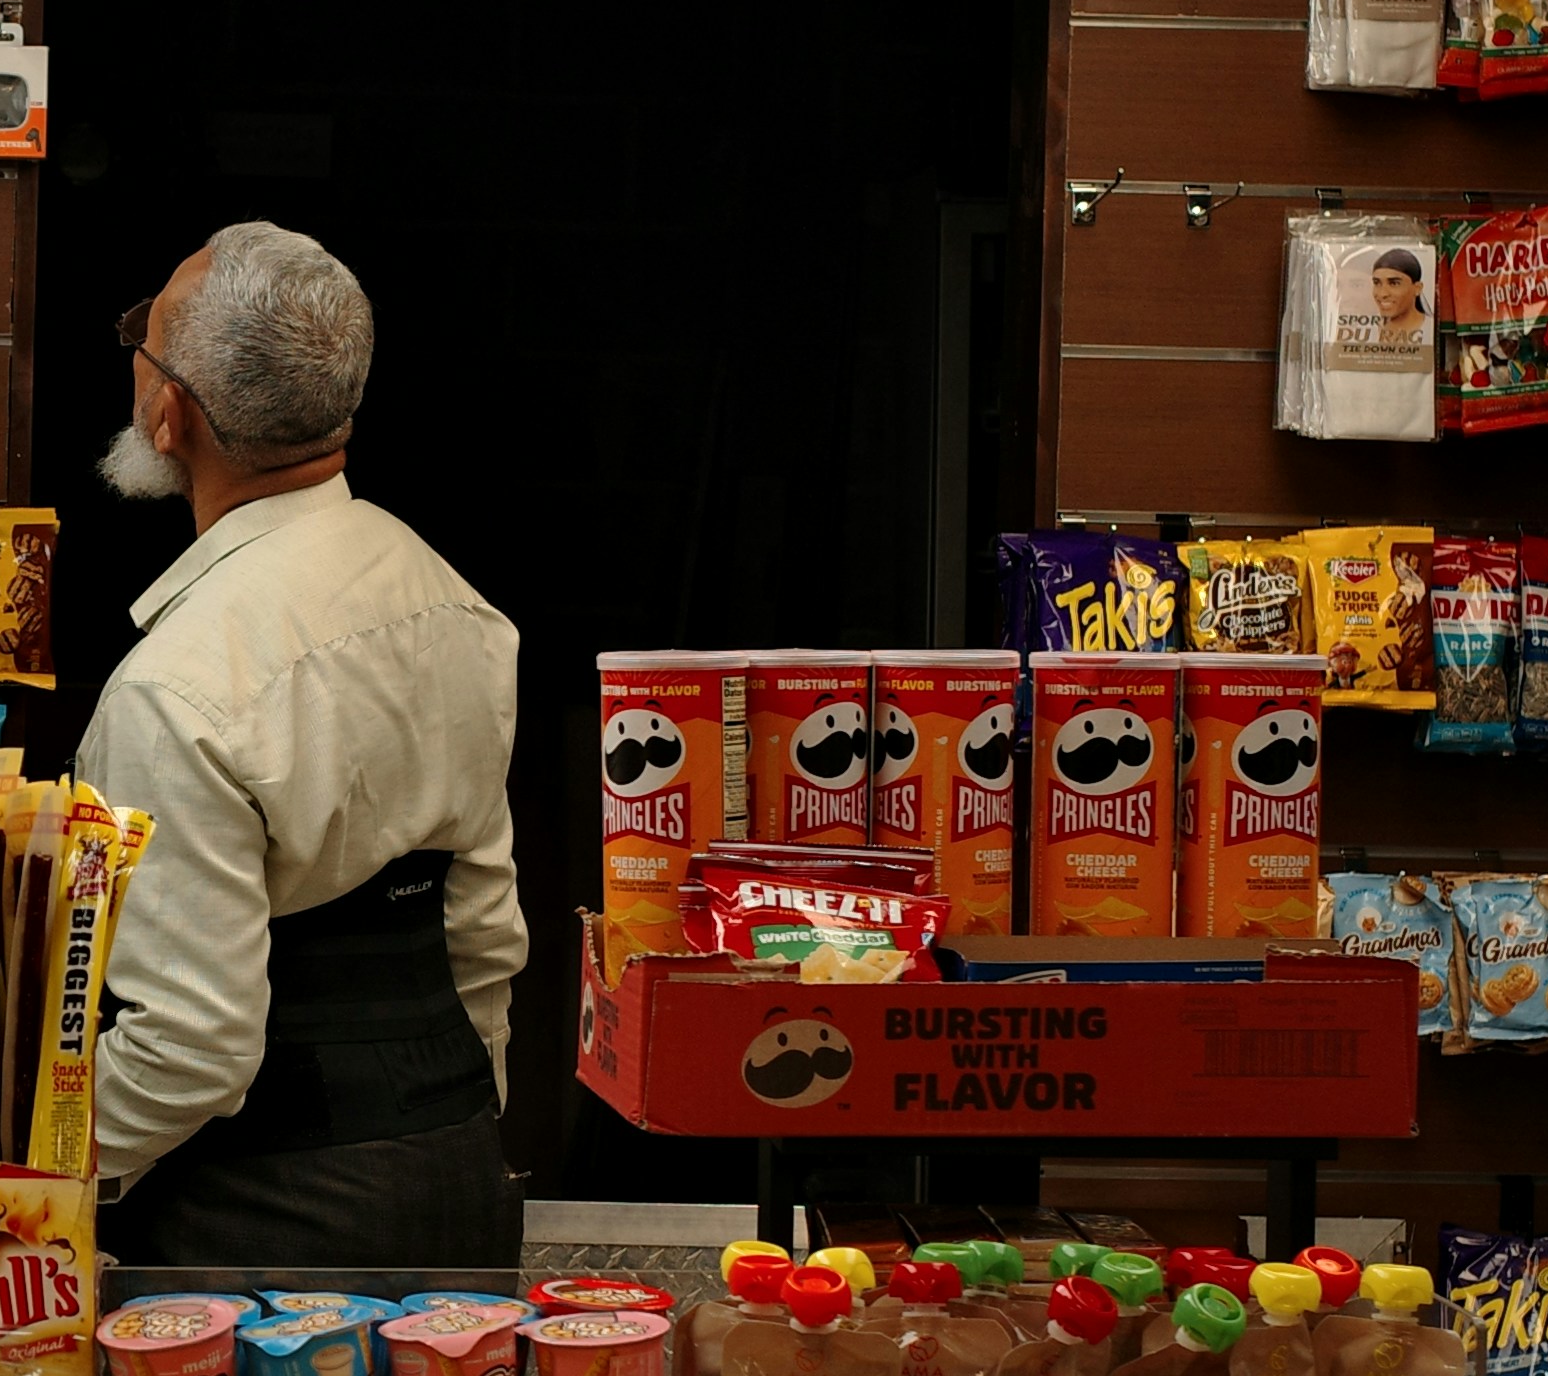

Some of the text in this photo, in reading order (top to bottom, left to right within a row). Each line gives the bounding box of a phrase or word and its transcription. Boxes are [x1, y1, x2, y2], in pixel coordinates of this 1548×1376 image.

[1338, 314, 1390, 326] SPORT
[1337, 328, 1424, 344] DU RAG
[1334, 590, 1379, 602] FUDGE
[1334, 602, 1380, 614] STRIPES
[1055, 582, 1177, 653] Takis
[1044, 684, 1166, 696] BURSTING WITH FLAVOR
[1050, 791, 1153, 838] PRINGLES
[1065, 854, 1138, 869] CHEDDAR
[1075, 866, 1128, 879] CHEESE
[60, 906, 96, 1056] BIGGEST
[885, 1007, 1108, 1041] BURSTING
[952, 1043, 1039, 1069] WITH
[52, 1060, 88, 1078] Snack
[52, 1076, 86, 1094] Stick
[892, 1072, 1098, 1112] FLAVOR
[181, 1350, 223, 1373] meiji
